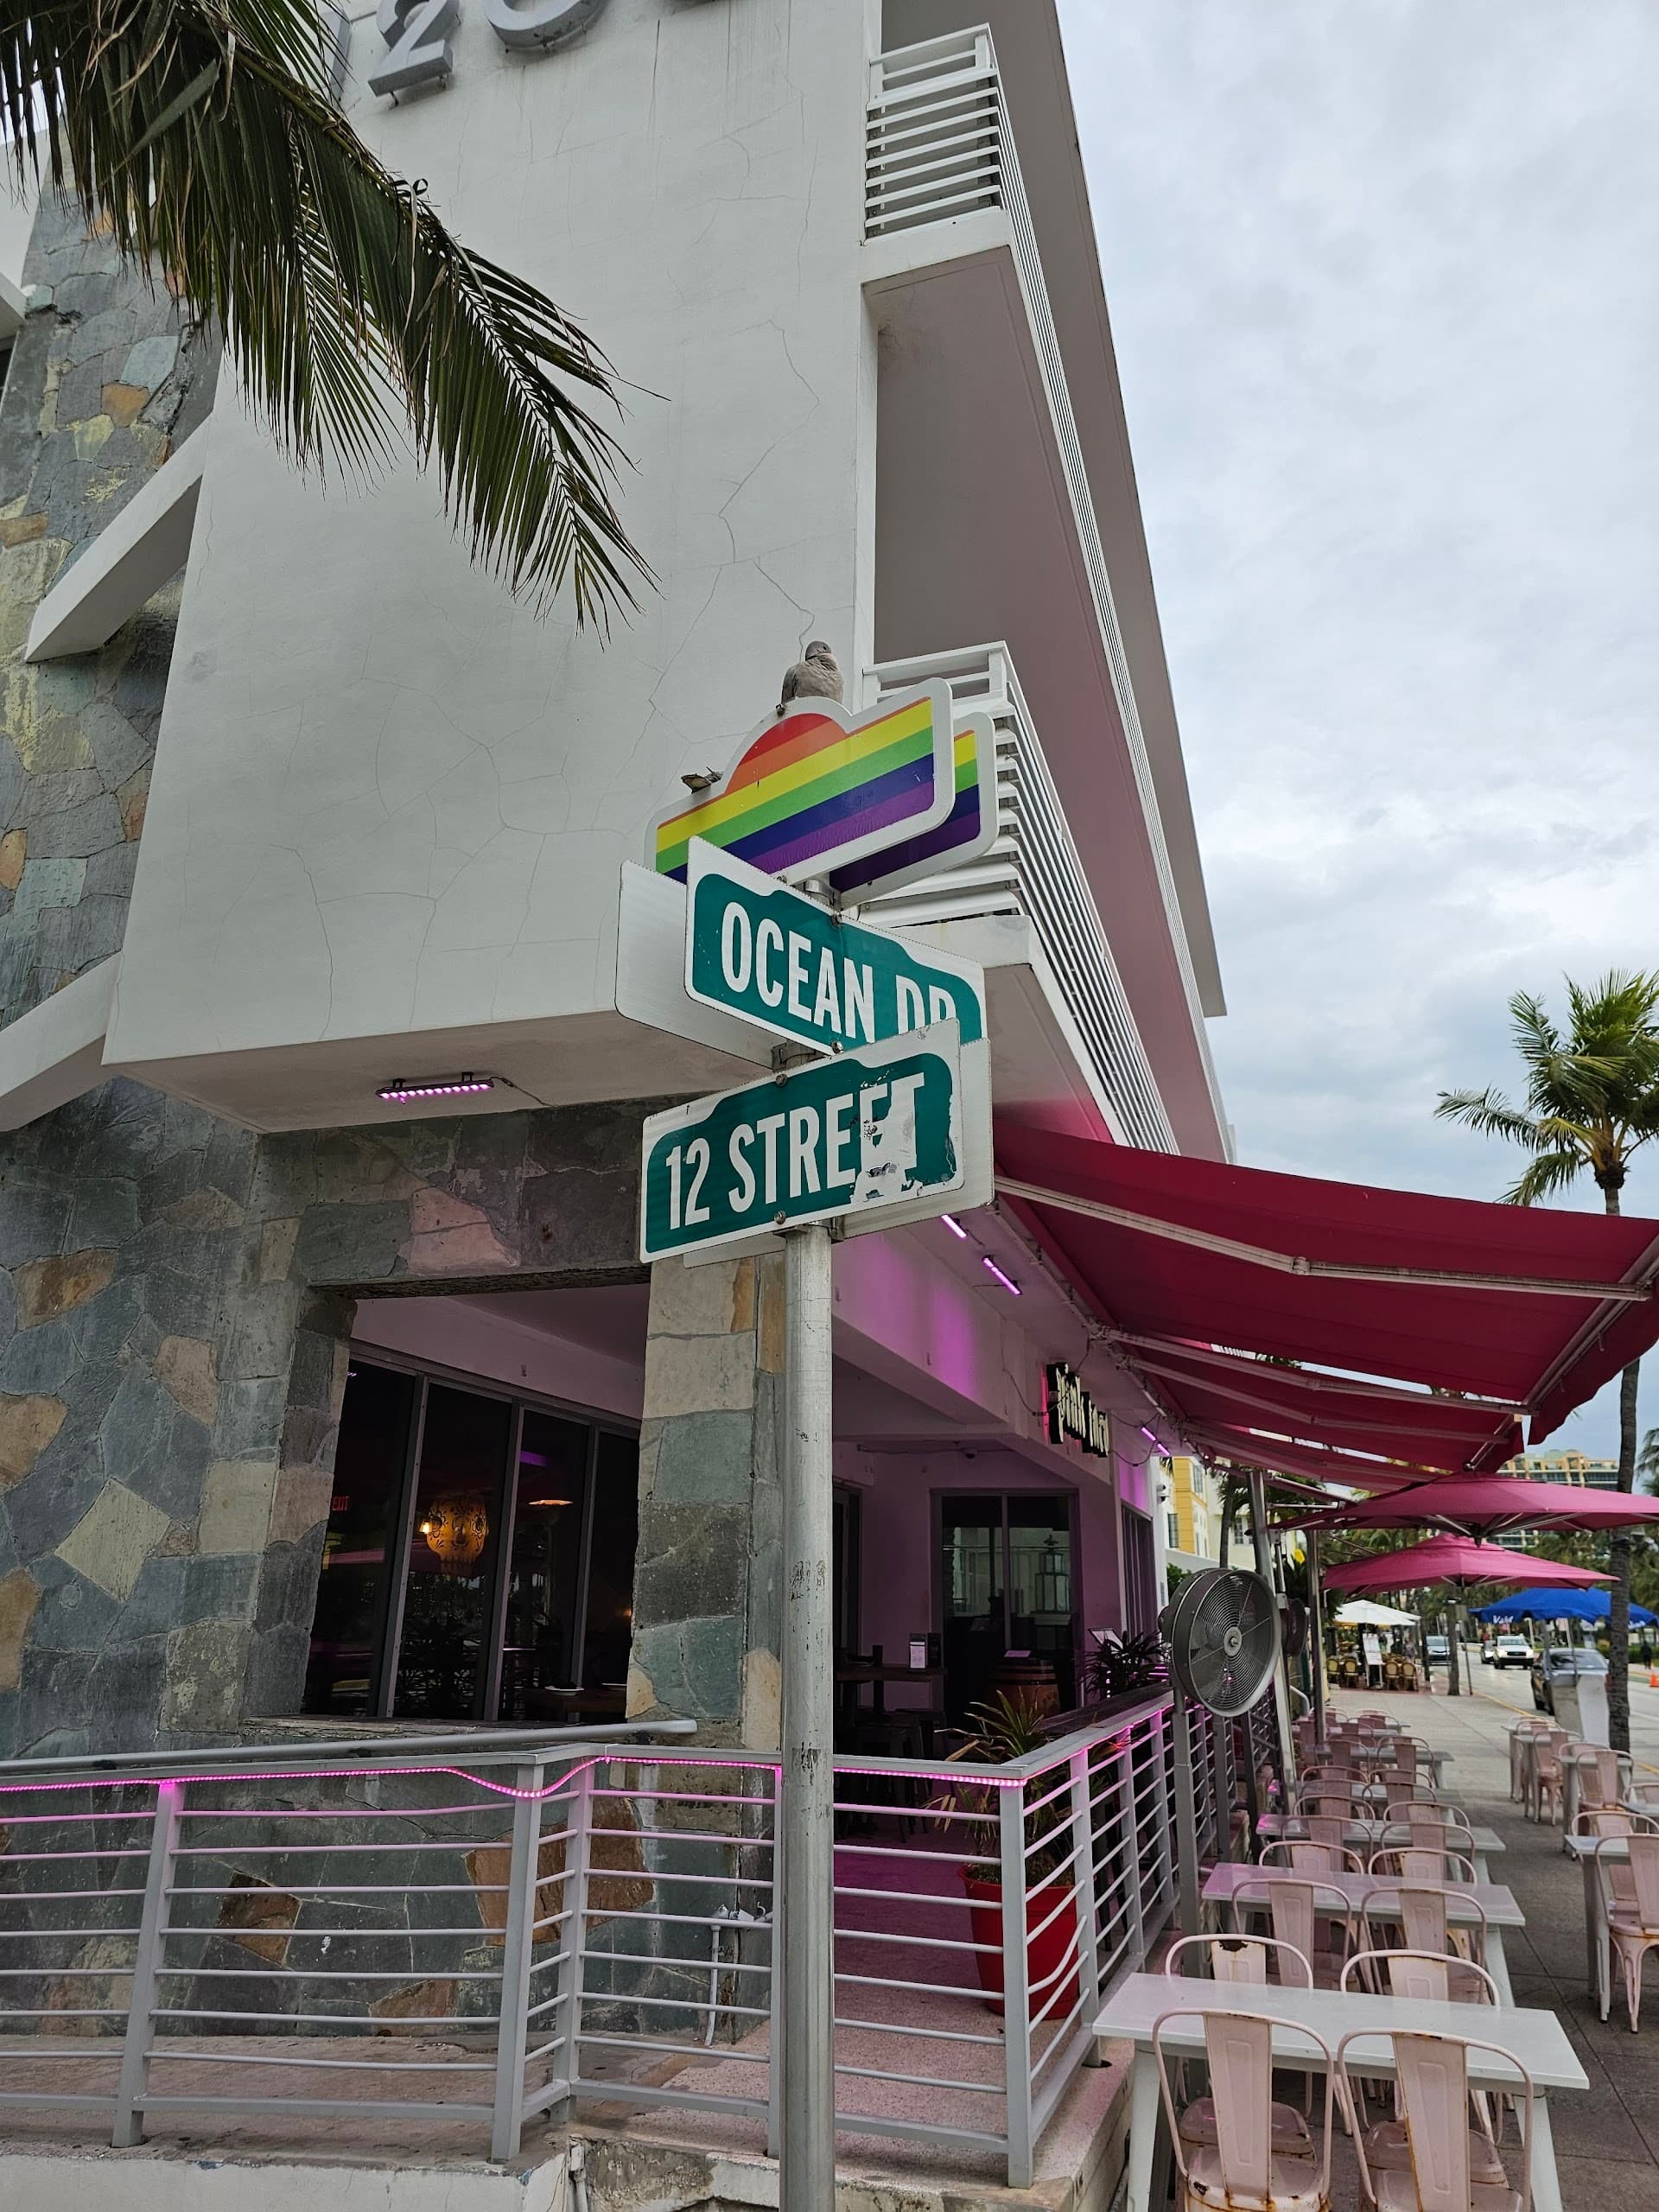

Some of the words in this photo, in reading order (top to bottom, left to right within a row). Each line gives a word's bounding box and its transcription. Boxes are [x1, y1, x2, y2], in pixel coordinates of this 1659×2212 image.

[721, 902, 875, 1044] OCEAN
[666, 1138, 710, 1230] 12
[728, 1071, 925, 1213] STREET
